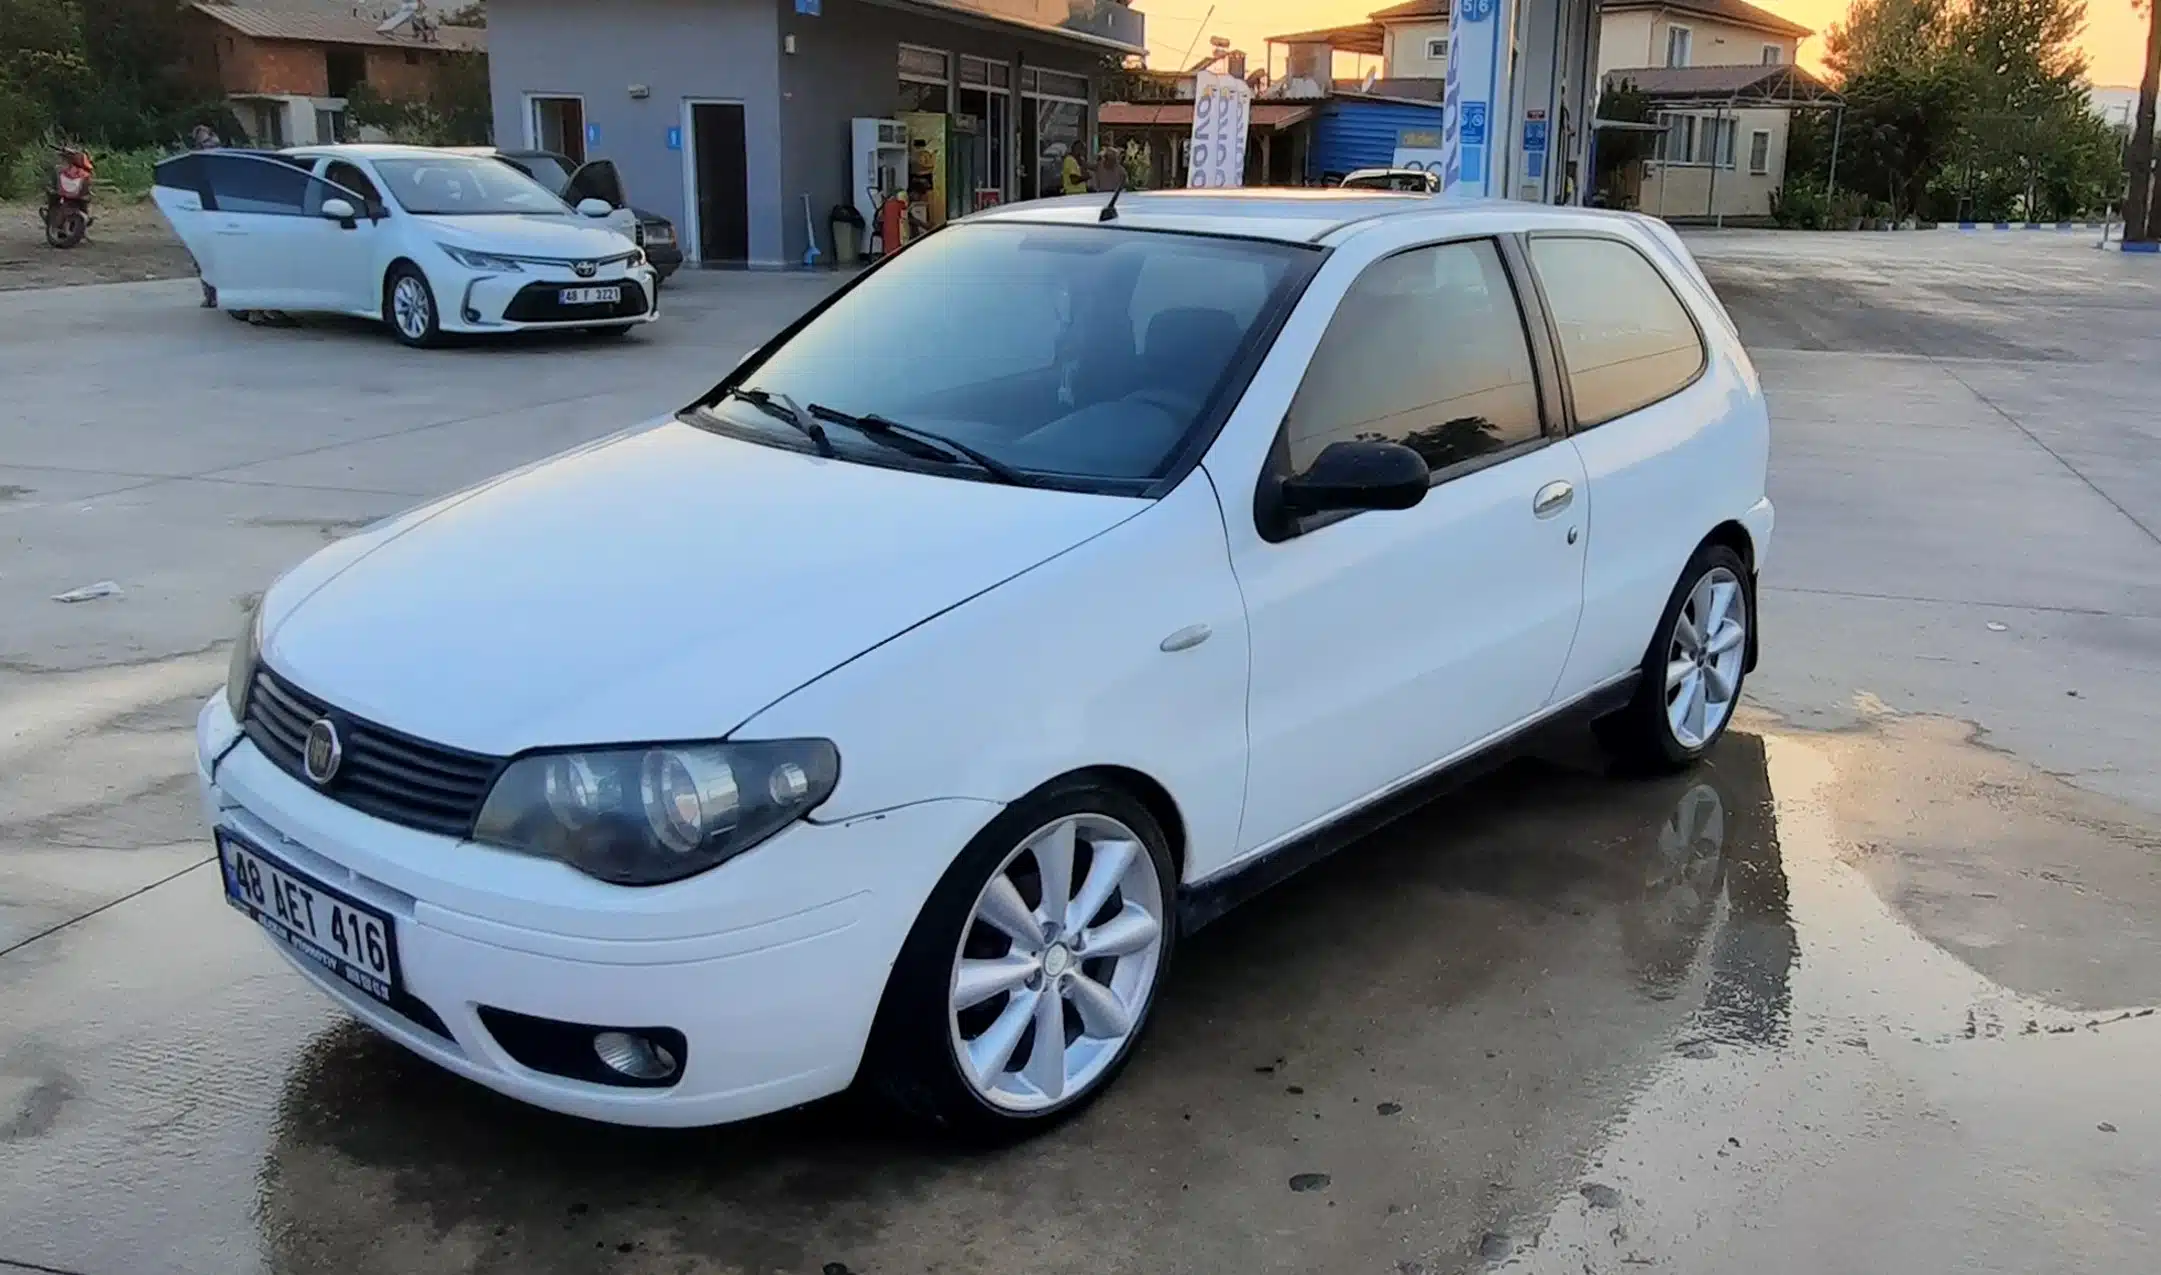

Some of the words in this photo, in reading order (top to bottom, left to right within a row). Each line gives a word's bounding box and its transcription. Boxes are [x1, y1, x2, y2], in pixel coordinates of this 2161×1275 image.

[1478, 0, 1490, 13] 6
[566, 290, 578, 301] 48
[236, 851, 265, 905] 48
[272, 872, 317, 938] AET
[331, 905, 385, 973] 416
